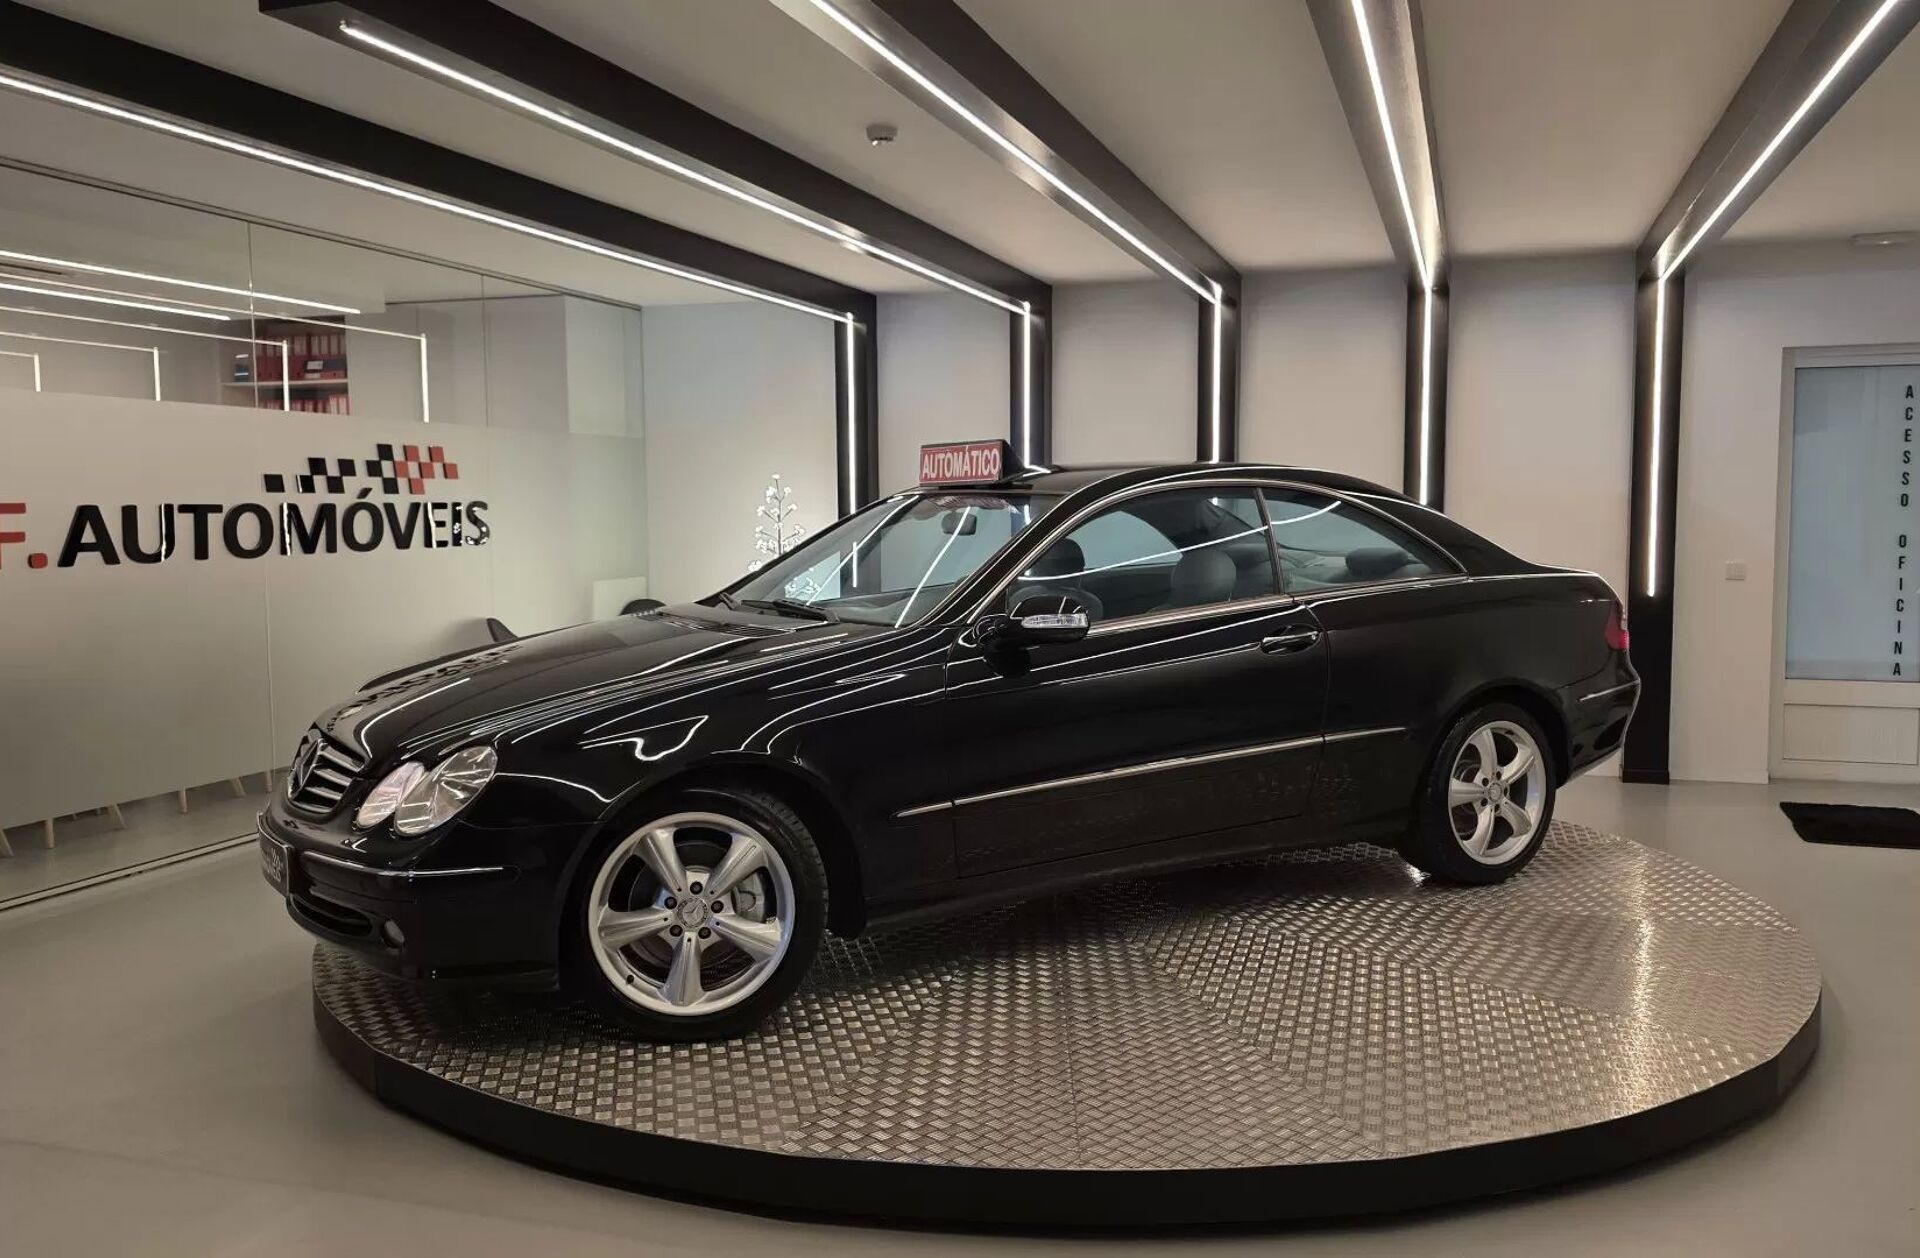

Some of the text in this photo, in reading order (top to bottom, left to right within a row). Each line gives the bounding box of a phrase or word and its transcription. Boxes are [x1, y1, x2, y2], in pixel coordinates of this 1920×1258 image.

[922, 445, 1001, 479] AUTOMÁTICO
[57, 487, 490, 568] AUTOMÓVEIS
[1892, 384, 1914, 676] ACESSO OFICINA
